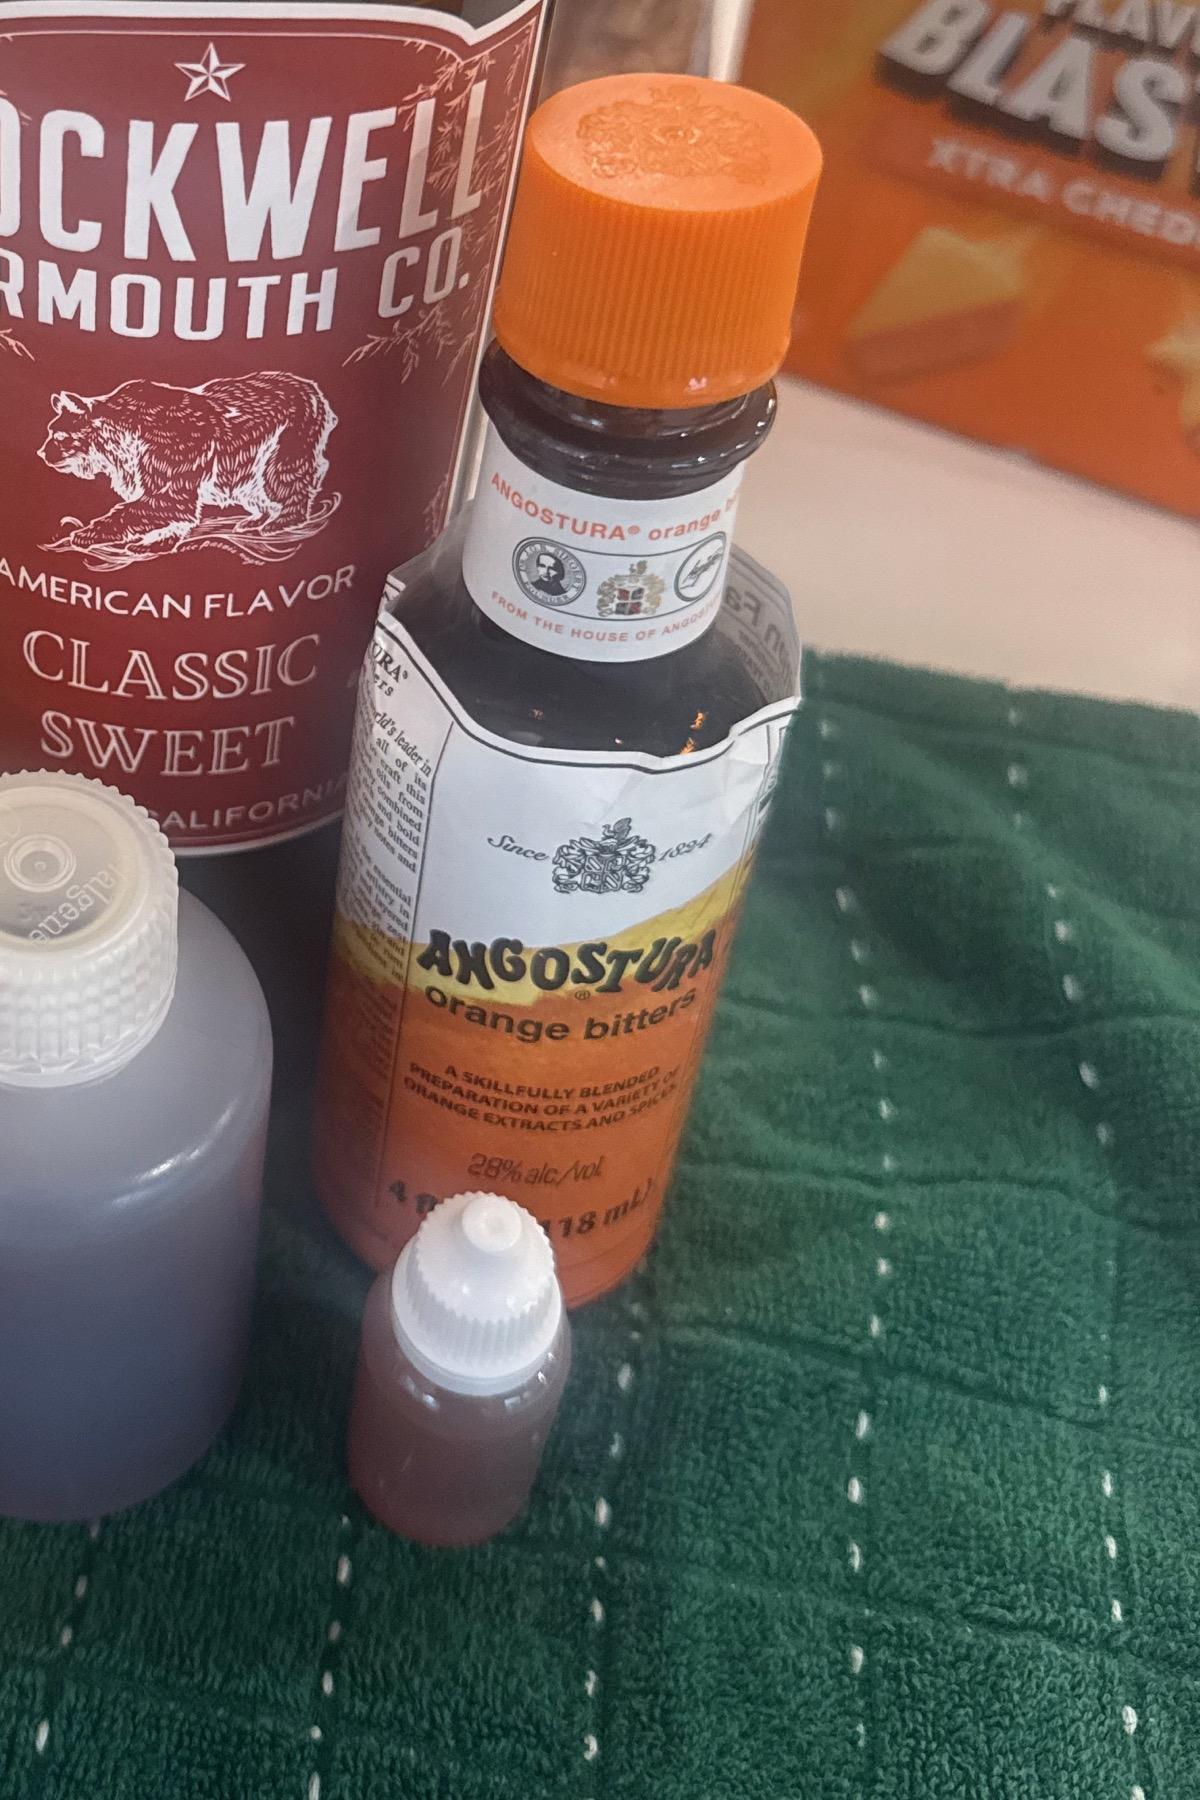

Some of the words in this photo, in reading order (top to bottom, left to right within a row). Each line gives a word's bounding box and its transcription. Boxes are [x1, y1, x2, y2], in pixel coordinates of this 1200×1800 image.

[880, 0, 1200, 168] BLAS
[928, 138, 1050, 204] XTRA
[1063, 180, 1200, 247] CHED
[376, 227, 470, 319] CO.
[648, 508, 721, 542] orange
[204, 564, 356, 619] FLAVOR
[491, 591, 528, 620] FROM
[533, 616, 563, 635] THE
[571, 629, 629, 642] HOUSE
[636, 629, 657, 641] OF
[22, 630, 320, 700] CLASSIC
[40, 709, 296, 777] SWEET
[394, 730, 423, 765] leader
[420, 759, 432, 778] in
[487, 832, 550, 862] Since
[416, 929, 716, 993] ANGOSTURA
[425, 986, 571, 1044] orange
[583, 986, 696, 1041] bitters
[403, 1076, 480, 1120] ORANGE
[483, 1112, 582, 1131] EXTRACTS
[587, 1110, 626, 1129] AND
[410, 1062, 539, 1114] PREPARATION
[543, 1104, 570, 1115] OF
[575, 1104, 587, 1115] A
[592, 1081, 659, 1112] VARIETY
[445, 1065, 457, 1078] A
[462, 1071, 574, 1099] SKILLFULLY
[580, 1065, 660, 1098] BLENDED
[467, 1153, 522, 1184] 28%
